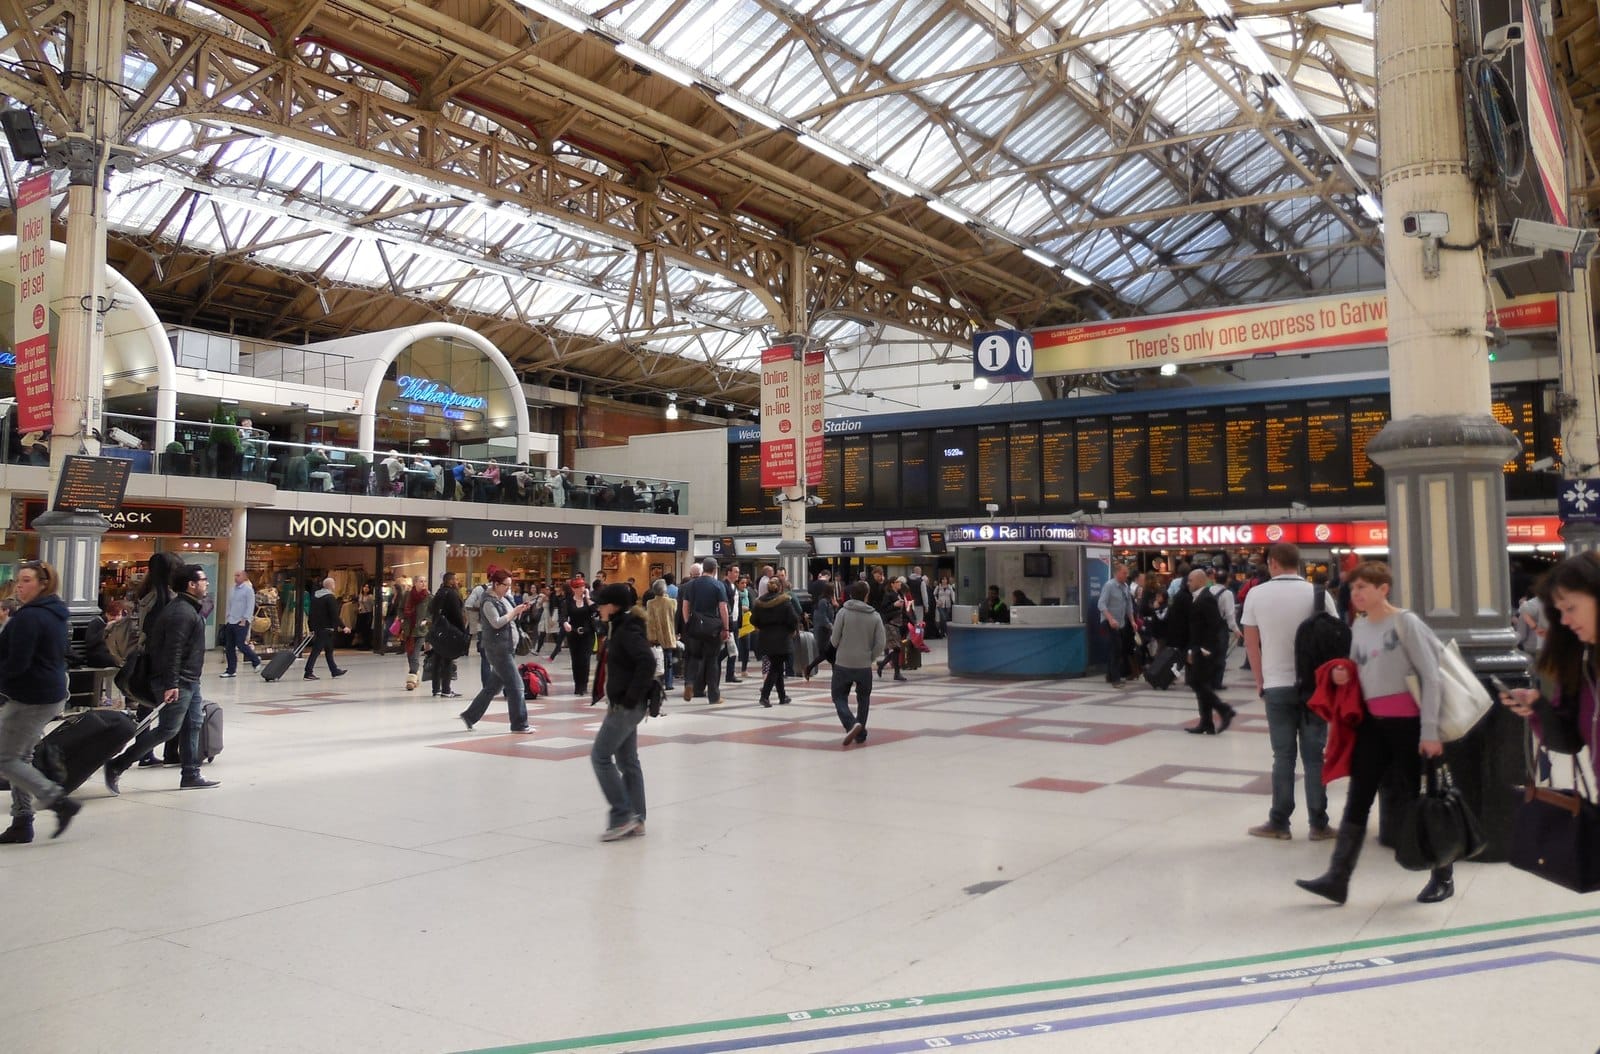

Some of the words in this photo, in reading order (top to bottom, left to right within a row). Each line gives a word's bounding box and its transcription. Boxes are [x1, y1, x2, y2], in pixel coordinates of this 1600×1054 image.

[23, 217, 43, 242] Inkjet
[20, 251, 31, 273] for
[33, 245, 45, 267] the
[20, 277, 31, 303] jet
[32, 271, 45, 295] set
[1127, 333, 1179, 361] There's
[1183, 327, 1214, 350] only
[1219, 326, 1248, 346] one
[1251, 313, 1316, 341] express
[1319, 309, 1337, 329] to
[763, 370, 788, 386] Online
[397, 375, 483, 412] Wetherspoons
[775, 385, 789, 399] not
[810, 388, 822, 400] the
[765, 401, 791, 417] in-line
[810, 403, 822, 415] set
[824, 420, 861, 433] Station
[769, 443, 781, 452] Save
[778, 459, 794, 467] online
[289, 515, 407, 539] MONSOON
[1000, 525, 1026, 539] Rail
[1029, 526, 1089, 540] information
[491, 528, 524, 538] OLIVER
[528, 530, 559, 540] BONAS
[651, 534, 676, 545] France
[1113, 526, 1195, 545] BURGER
[1197, 525, 1253, 544] KING
[715, 542, 722, 551] 9
[842, 540, 851, 550] 11
[824, 1005, 862, 1015] Park
[863, 1001, 891, 1010] Car
[962, 1028, 1020, 1041] Toilets
